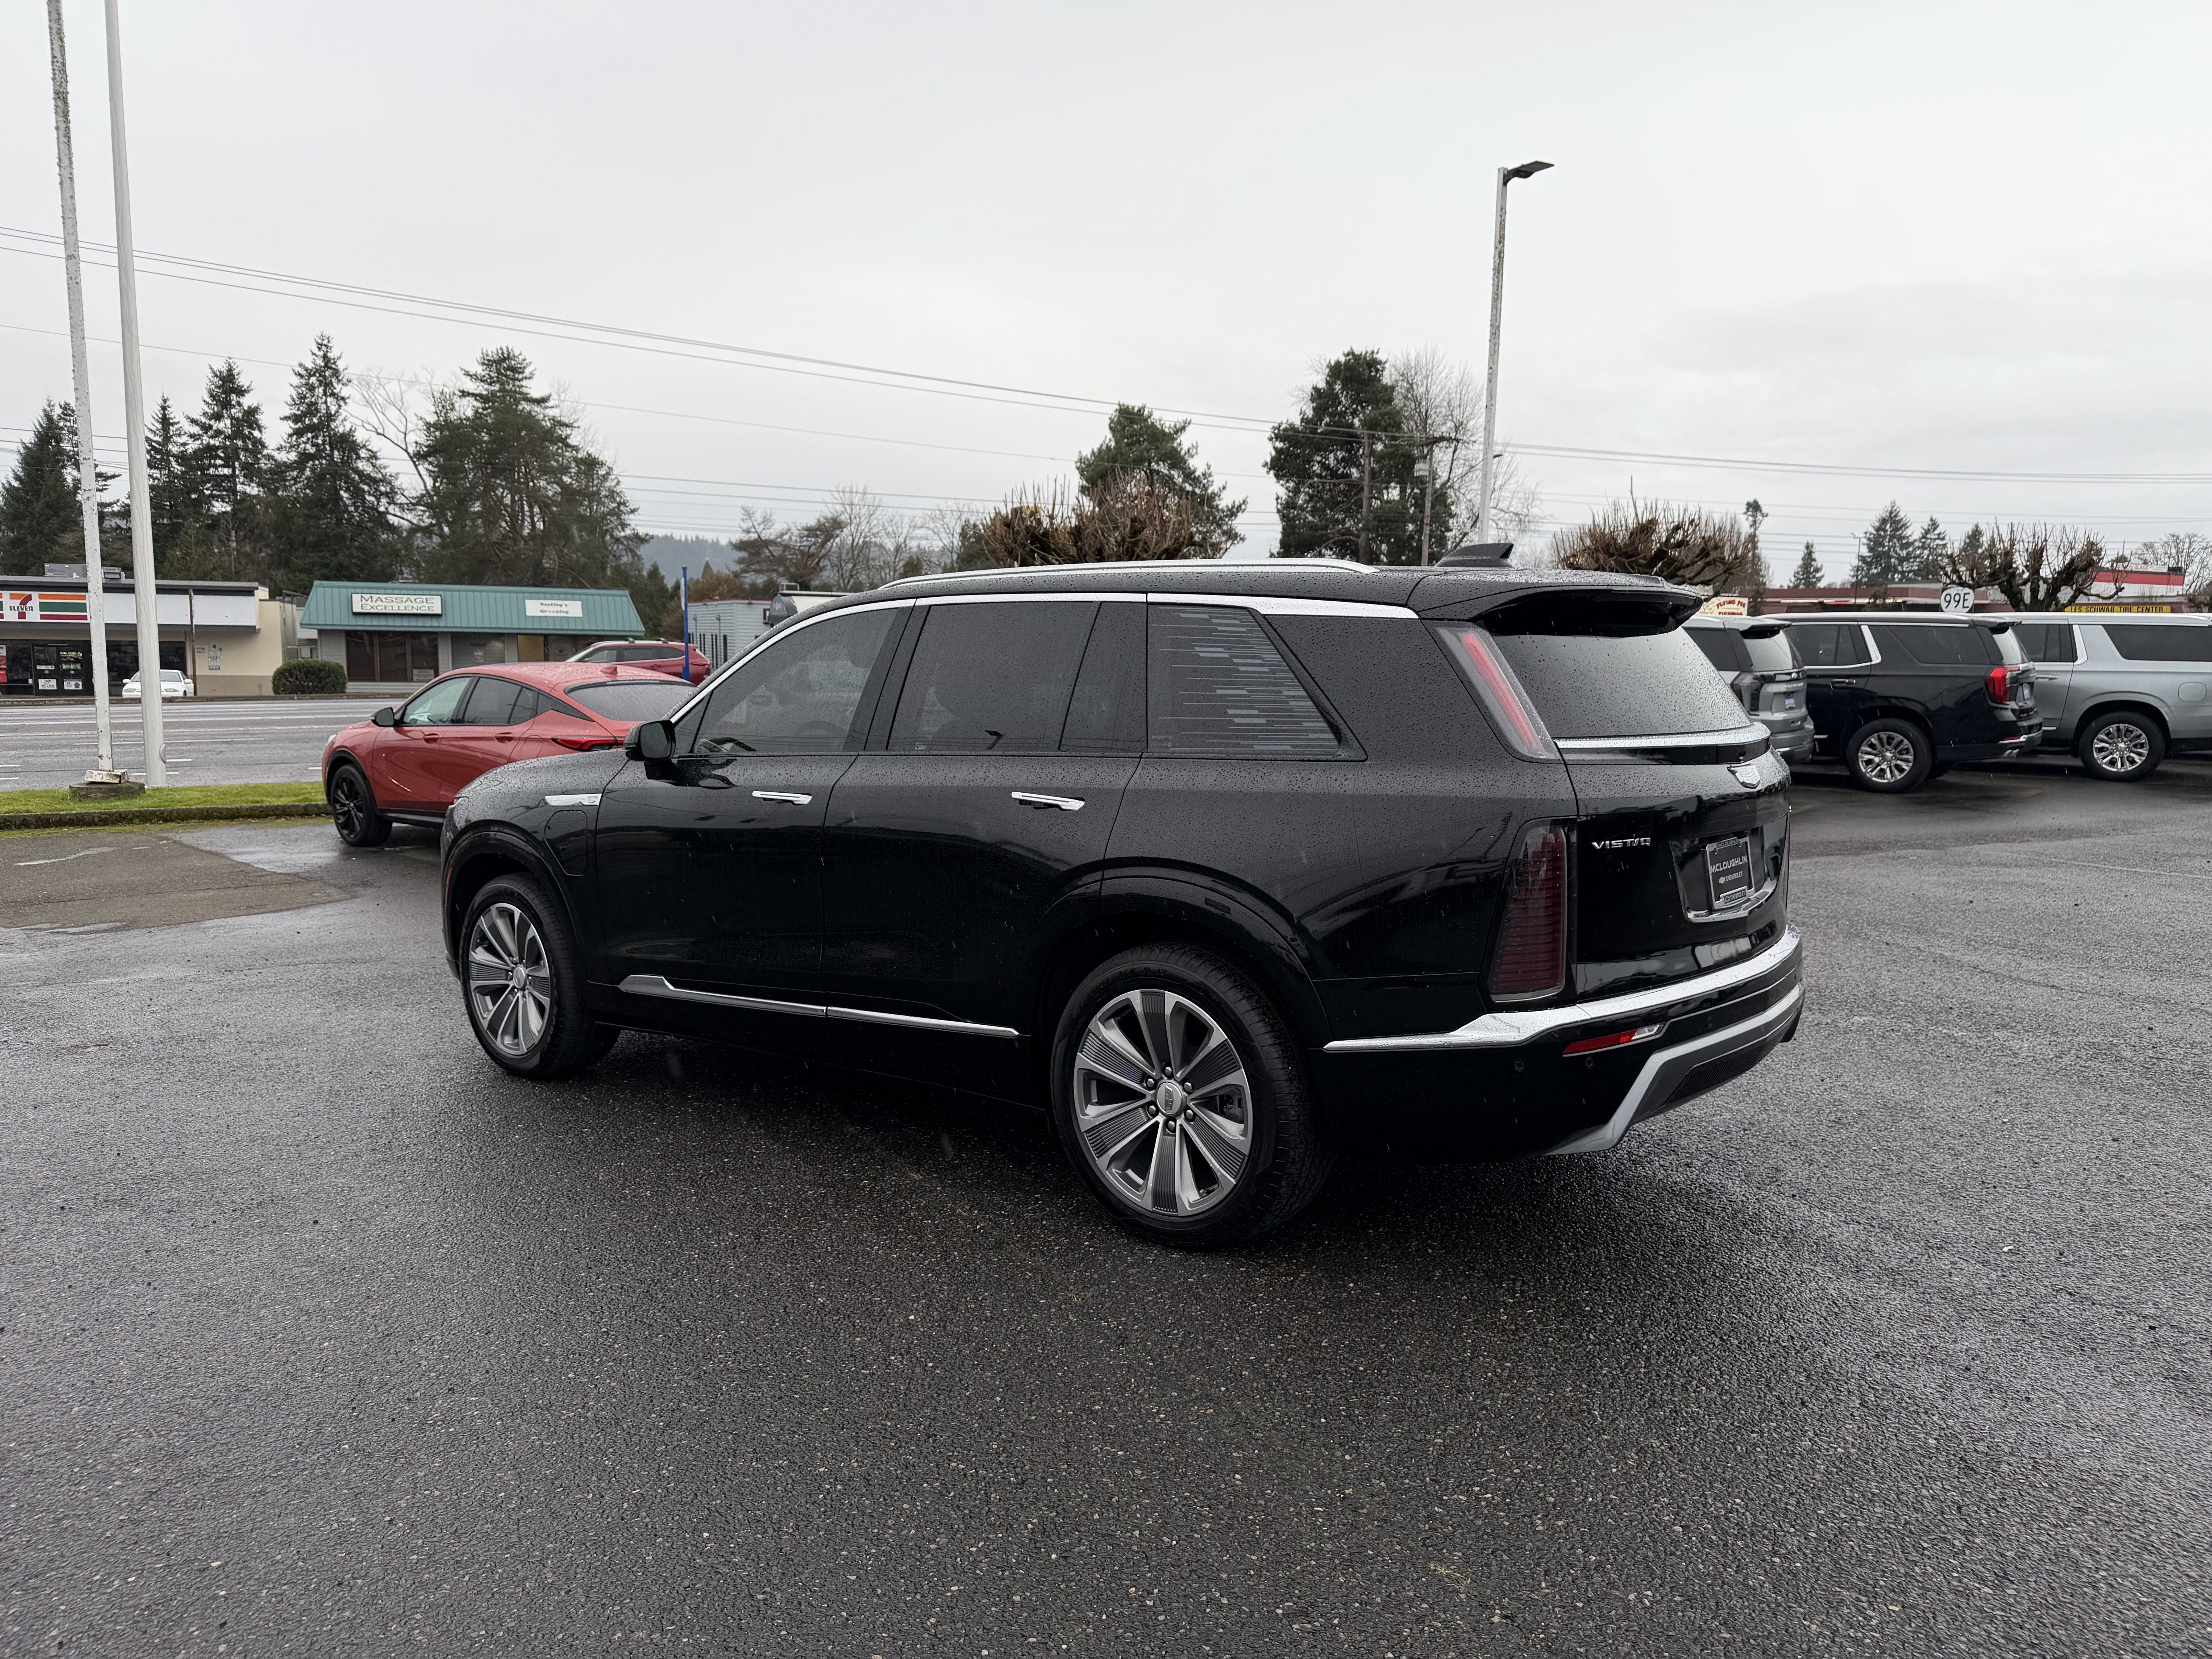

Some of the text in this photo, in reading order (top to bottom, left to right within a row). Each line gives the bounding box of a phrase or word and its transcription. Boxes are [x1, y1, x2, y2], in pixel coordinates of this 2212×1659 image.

[360, 595, 434, 604] MASSAGE
[1944, 592, 1970, 610] 99E
[1710, 855, 1748, 874] MCLOUGHLIN
